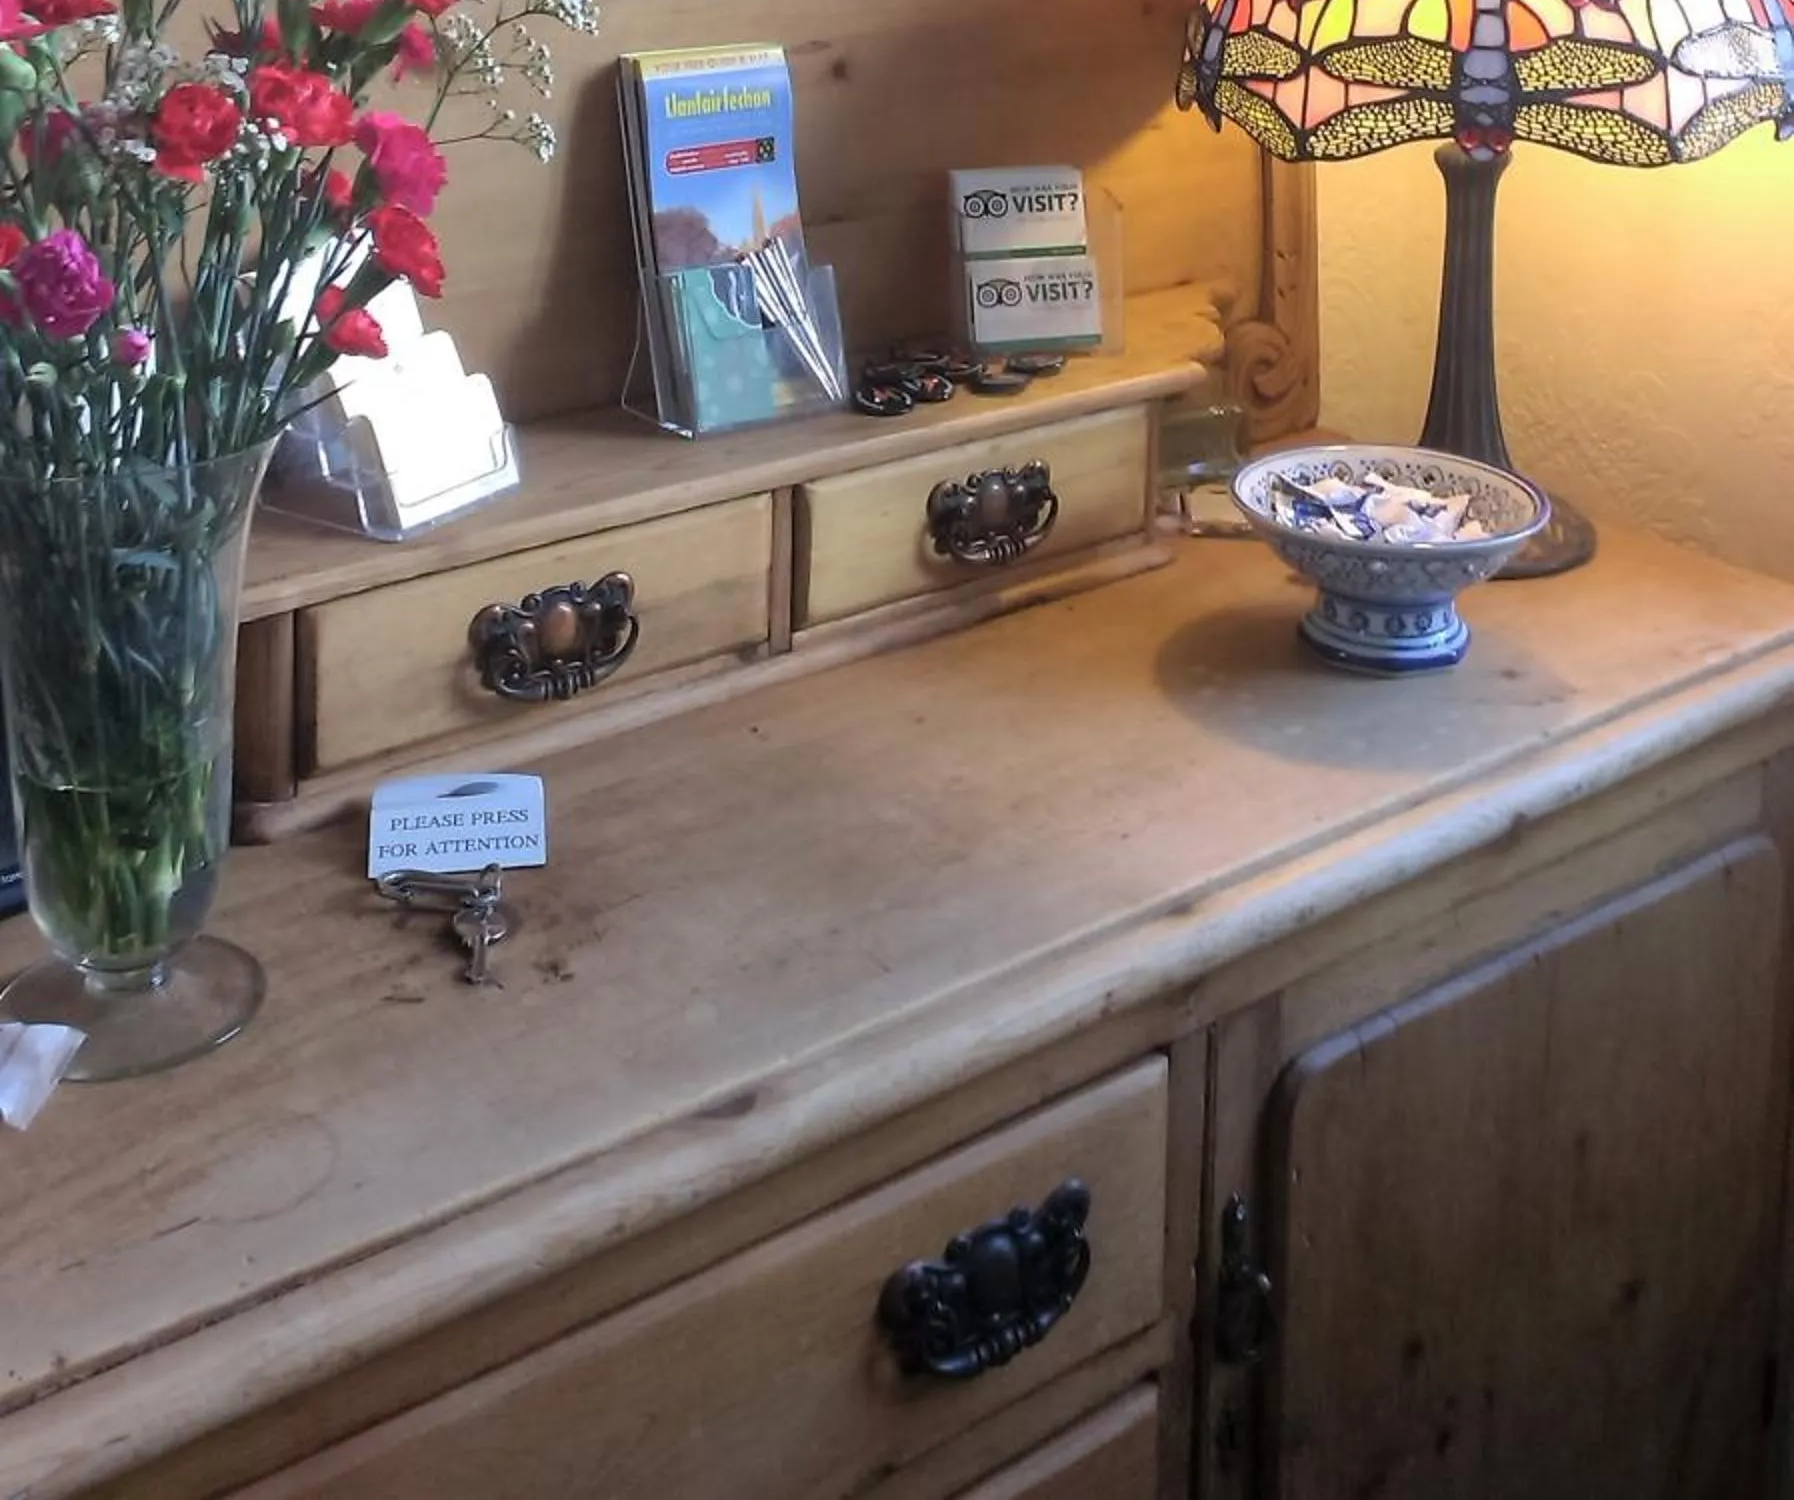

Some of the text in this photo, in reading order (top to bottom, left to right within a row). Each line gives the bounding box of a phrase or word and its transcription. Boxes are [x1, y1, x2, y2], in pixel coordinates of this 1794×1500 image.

[1012, 193, 1079, 213] VISIT?
[1025, 281, 1094, 303] VISIT?
[391, 809, 529, 832] PLEASE PRESS
[377, 835, 541, 860] FOR ATTENTION
